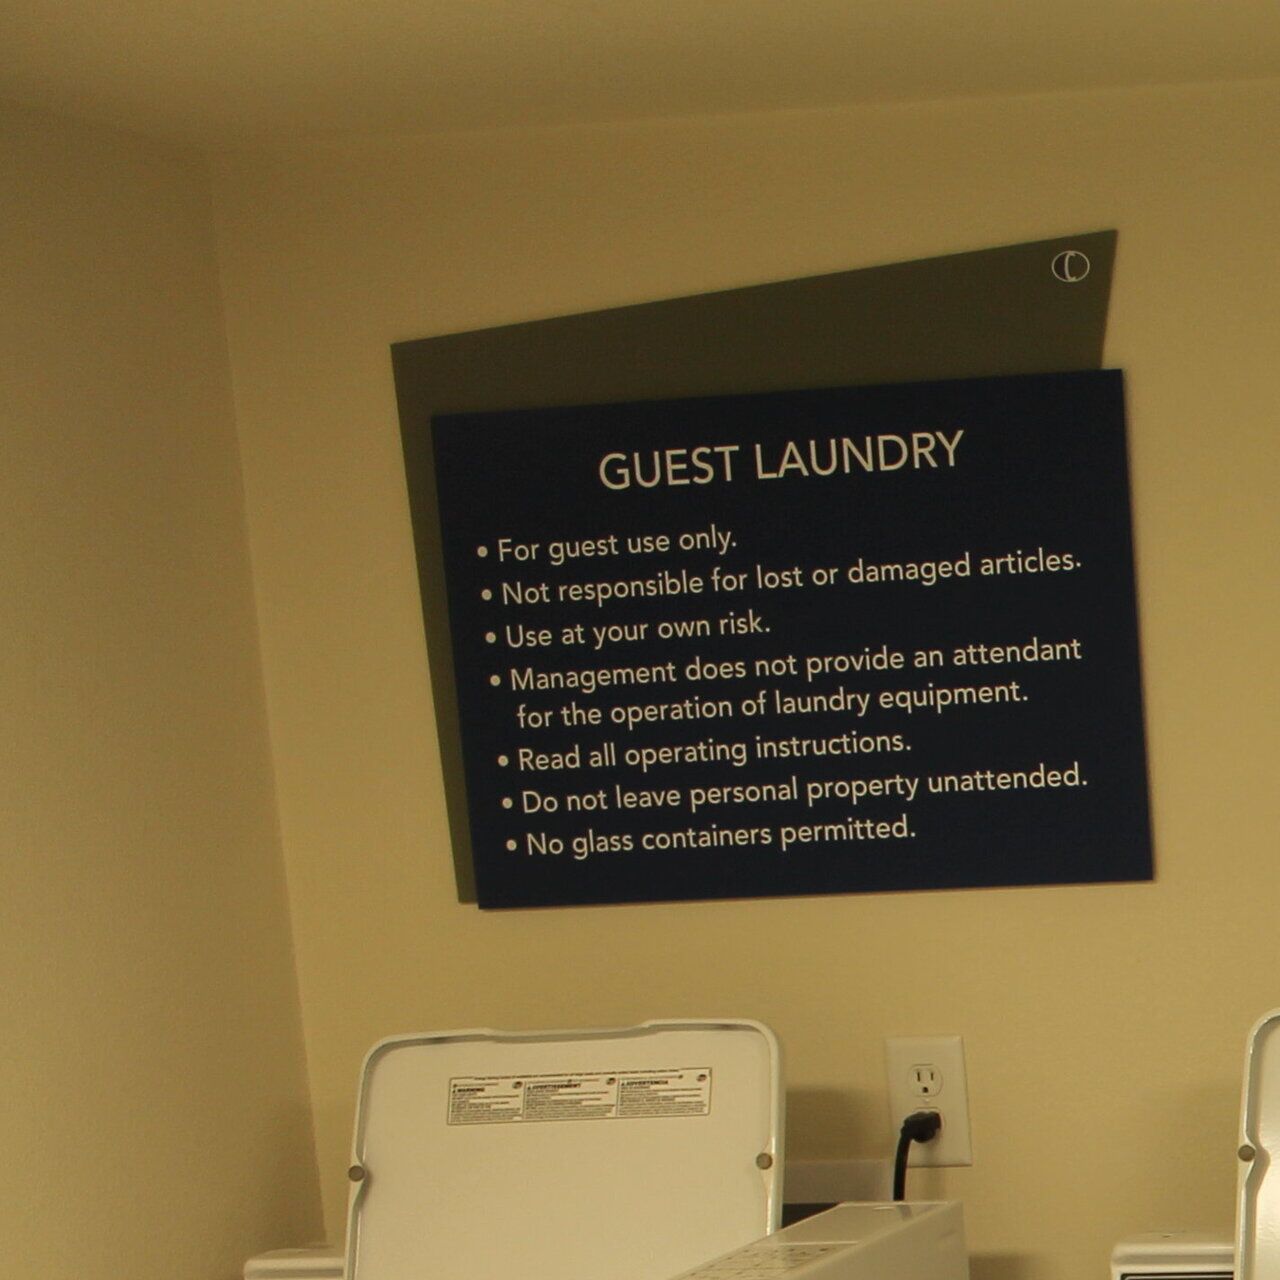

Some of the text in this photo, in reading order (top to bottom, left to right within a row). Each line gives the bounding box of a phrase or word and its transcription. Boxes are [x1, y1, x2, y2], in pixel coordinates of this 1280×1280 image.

[599, 429, 965, 490] GUEST LAUNDRY
[498, 523, 737, 566] For guest use only.
[502, 546, 1082, 608] Not responsible for lost or damaged articles.
[505, 608, 771, 651] Use at your own risk.
[510, 636, 1083, 694] Management does not provide an attendant
[516, 681, 1029, 731] for the operation of laundry equipment.
[518, 730, 912, 773] Read all operating instructions.
[522, 760, 1088, 814] Do not leave personal property unattended.
[526, 812, 916, 861] No glass containers permitted.
